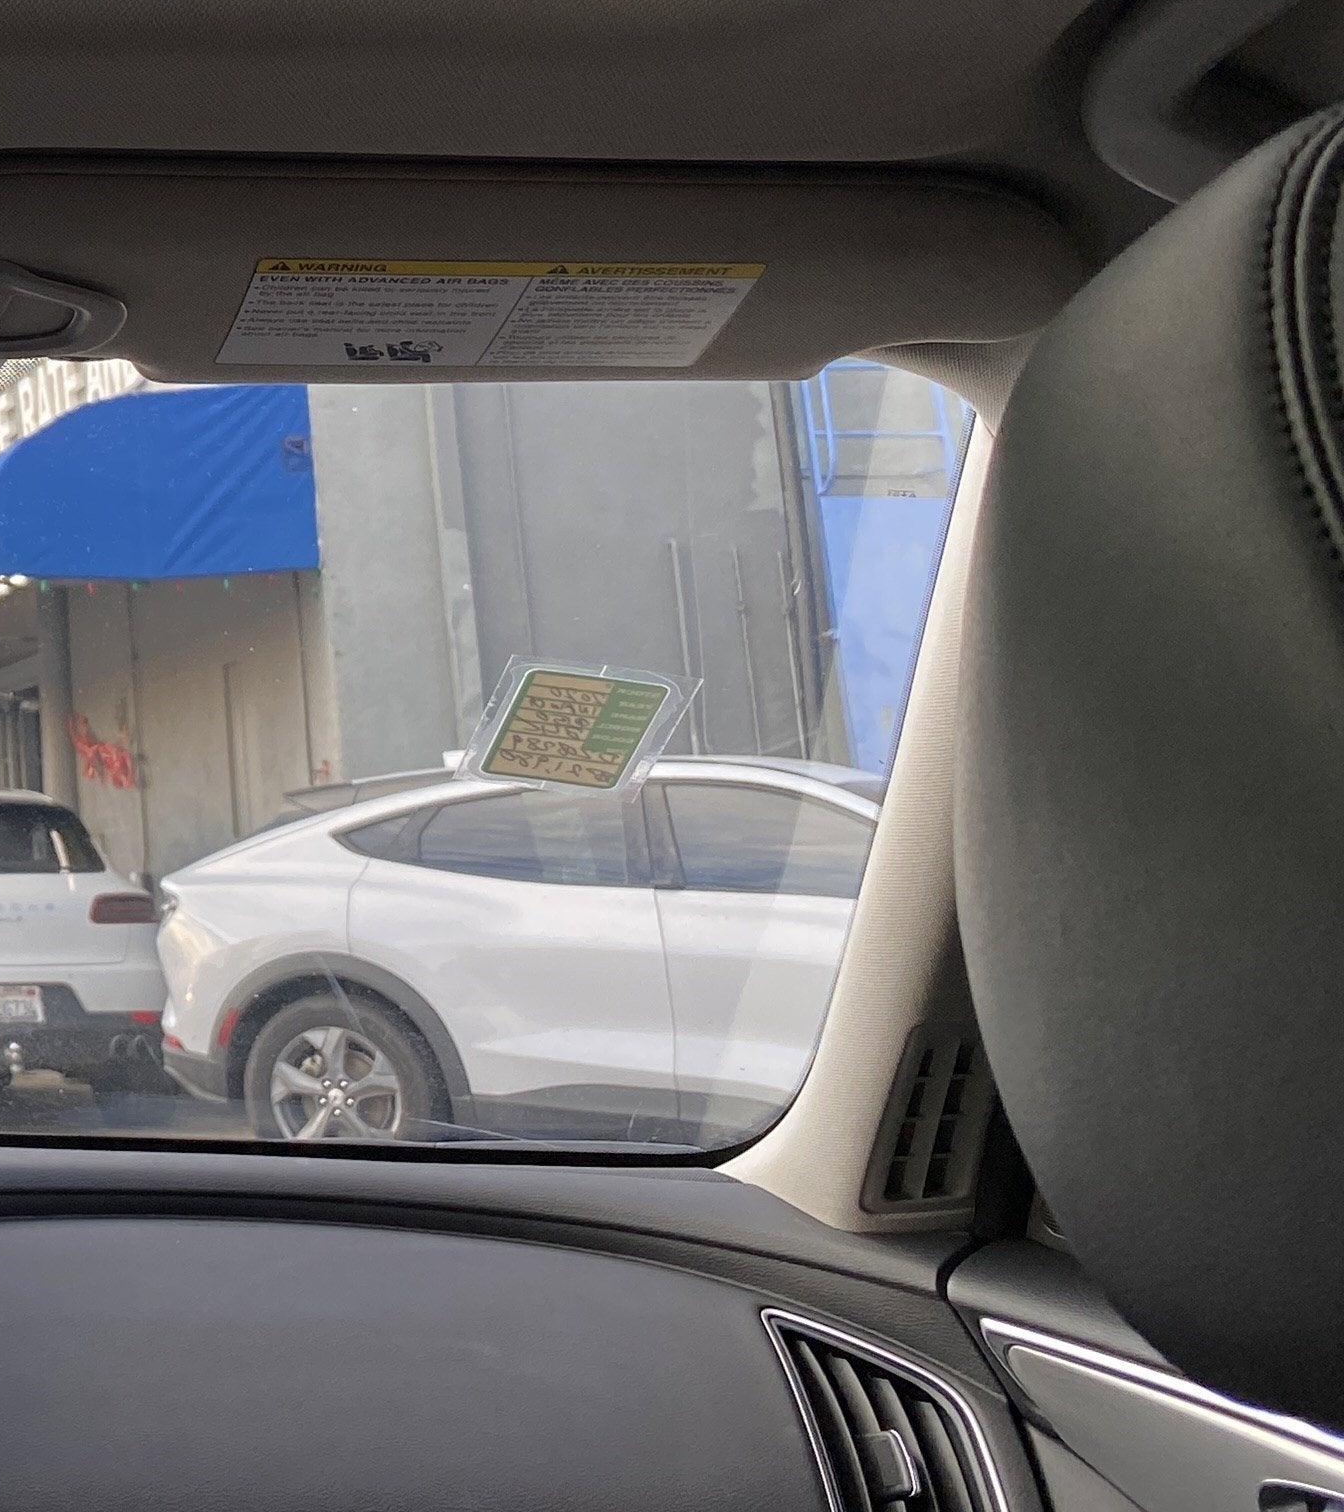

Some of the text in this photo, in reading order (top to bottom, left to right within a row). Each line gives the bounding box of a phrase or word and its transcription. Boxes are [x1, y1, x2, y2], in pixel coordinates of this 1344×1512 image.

[299, 263, 387, 272] WARNING
[577, 267, 733, 276] AVERTISSEMENT
[347, 276, 431, 284] ADVANCED
[17, 360, 86, 439] RATE
